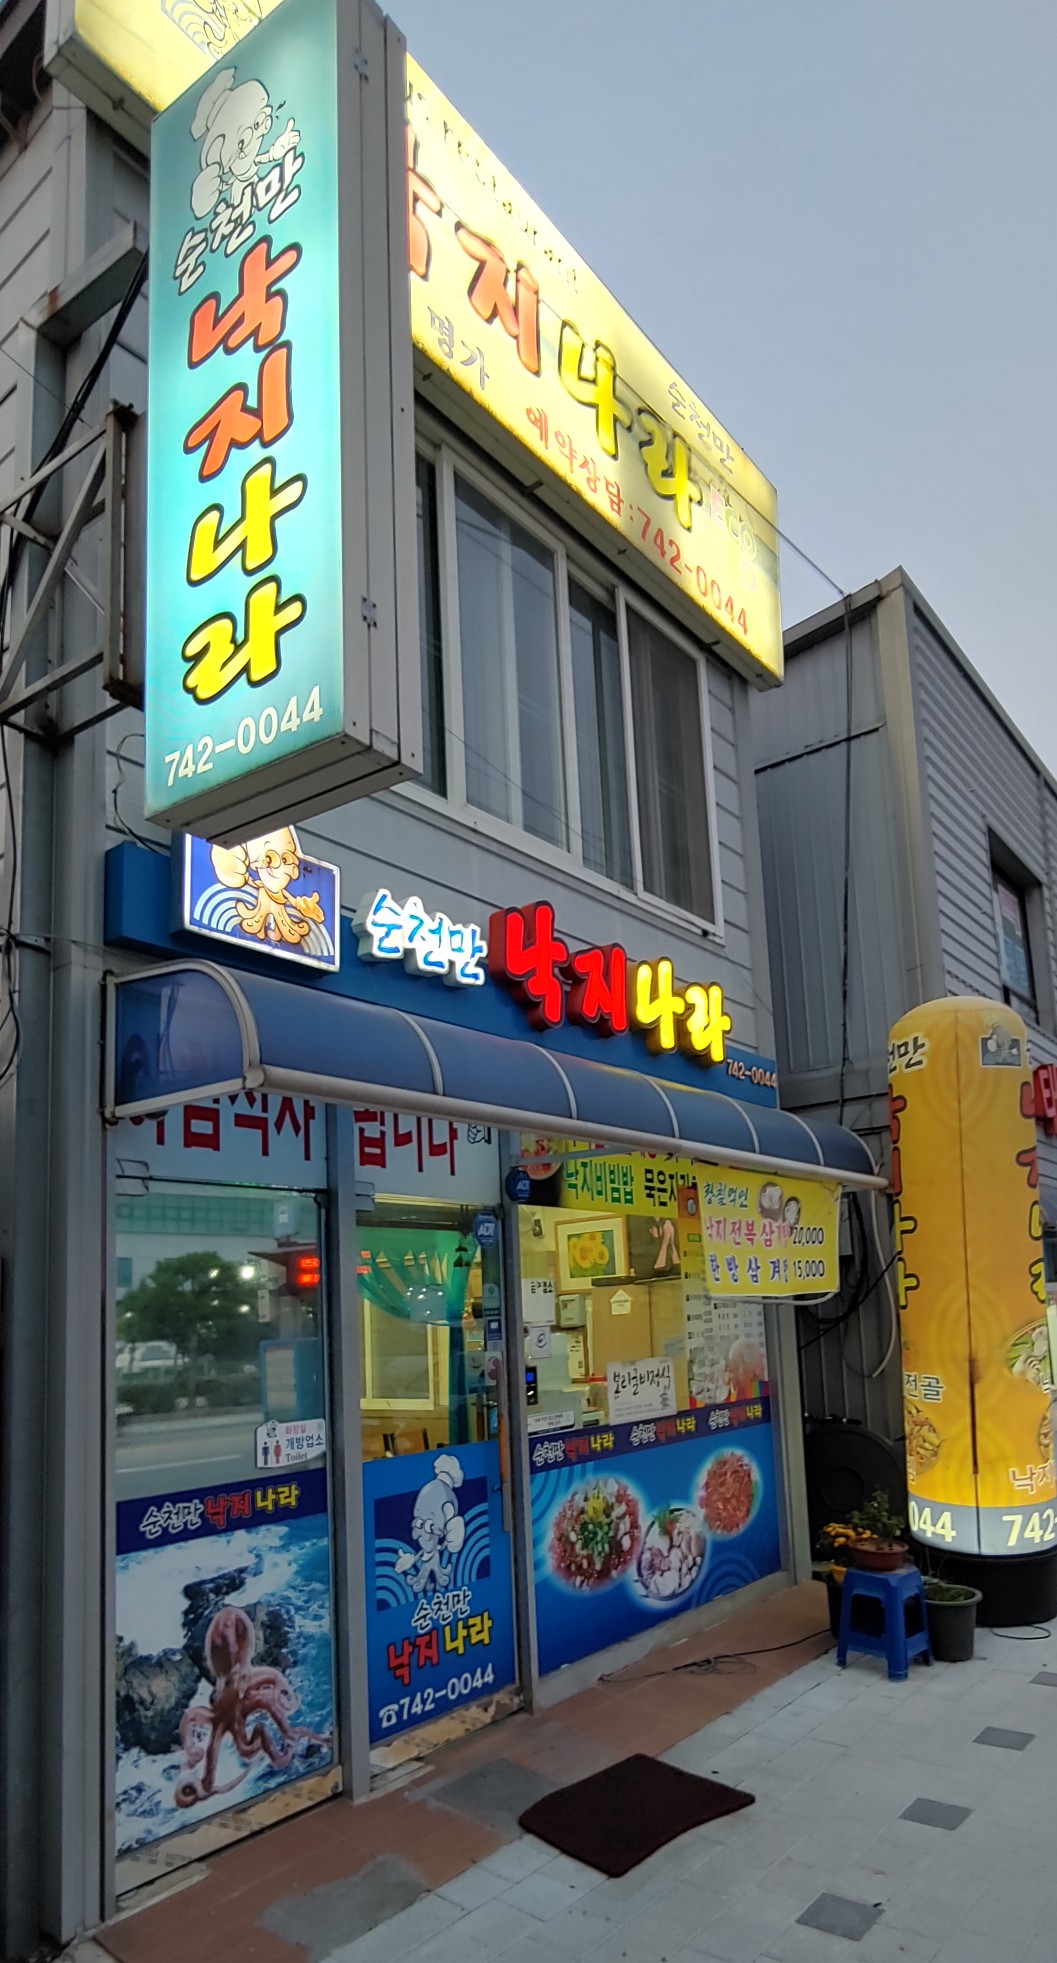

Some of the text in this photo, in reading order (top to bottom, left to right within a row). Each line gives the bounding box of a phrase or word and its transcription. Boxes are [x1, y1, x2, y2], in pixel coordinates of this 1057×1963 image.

[174, 153, 304, 296] 순천만
[426, 305, 490, 391] 명가
[667, 381, 735, 475] 순천만
[164, 685, 324, 788] 742-0044
[367, 889, 488, 986] 순천만
[725, 1058, 778, 1088] 742-0044
[563, 1158, 635, 1206] 낙지비빔밥
[477, 1223, 496, 1237] ADT
[793, 1226, 824, 1247] 20,000
[793, 1259, 826, 1280] 15,000
[285, 1433, 325, 1451] 개방업소
[532, 1439, 566, 1467] 순천만
[629, 1422, 657, 1447] 순천만
[285, 1452, 308, 1463] Toilet
[139, 1499, 204, 1540] 순천만
[411, 1586, 473, 1634] 순천만
[400, 1662, 495, 1721] 742-0044
